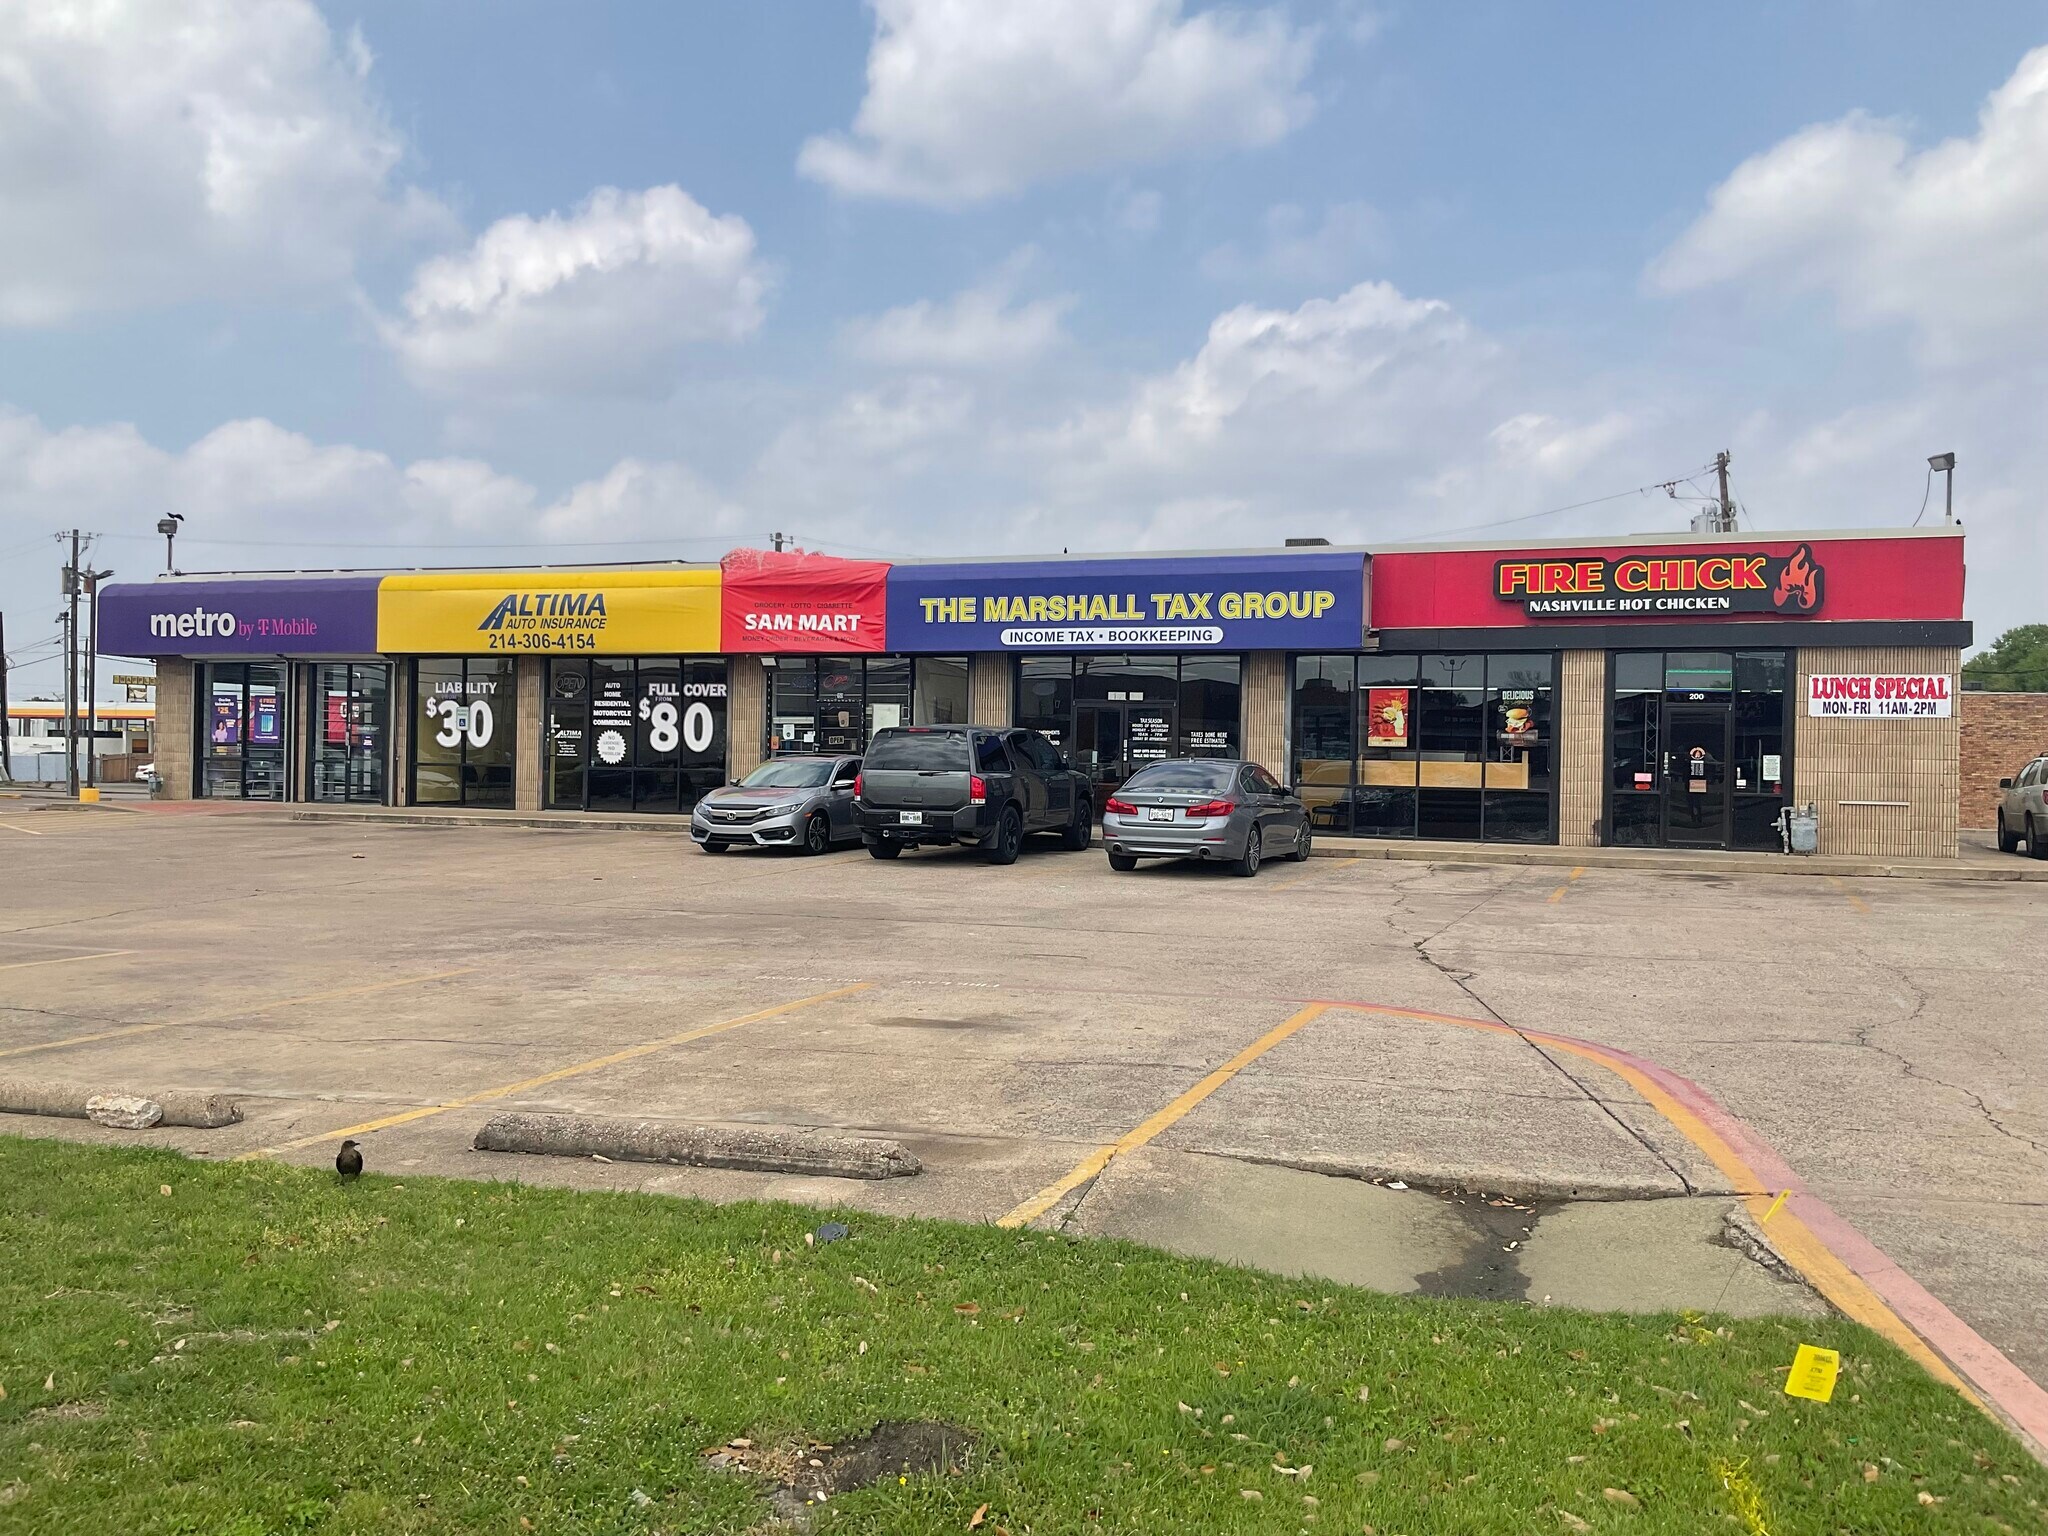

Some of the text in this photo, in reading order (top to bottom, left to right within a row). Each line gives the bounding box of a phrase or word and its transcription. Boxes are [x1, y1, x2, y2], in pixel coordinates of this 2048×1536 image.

[1500, 557, 1767, 594] FIRE CHICK
[478, 594, 606, 630] ALTIMA
[920, 590, 1335, 623] THE MARSHALL TAX GROUP
[1529, 598, 1730, 612] NASHVILLE HOT CHICKEN
[150, 607, 236, 638] metro
[239, 620, 255, 640] by
[506, 617, 607, 629] AUTO INSURANCE
[745, 613, 861, 631] SAM MART
[489, 633, 596, 649] 214-306-4154
[1009, 630, 1213, 643] INCOME TAX BOOKKEEPING
[435, 682, 497, 694] LIABILITY
[556, 677, 583, 689] OPEN
[648, 683, 727, 697] FULL COVER
[1811, 677, 1949, 699] LUNCH SPECIAL
[1502, 690, 1534, 700] DELICIOUS
[1822, 701, 1937, 715] MON-FRI 11AM-2PM
[426, 696, 493, 748] $30
[639, 697, 714, 753] $80
